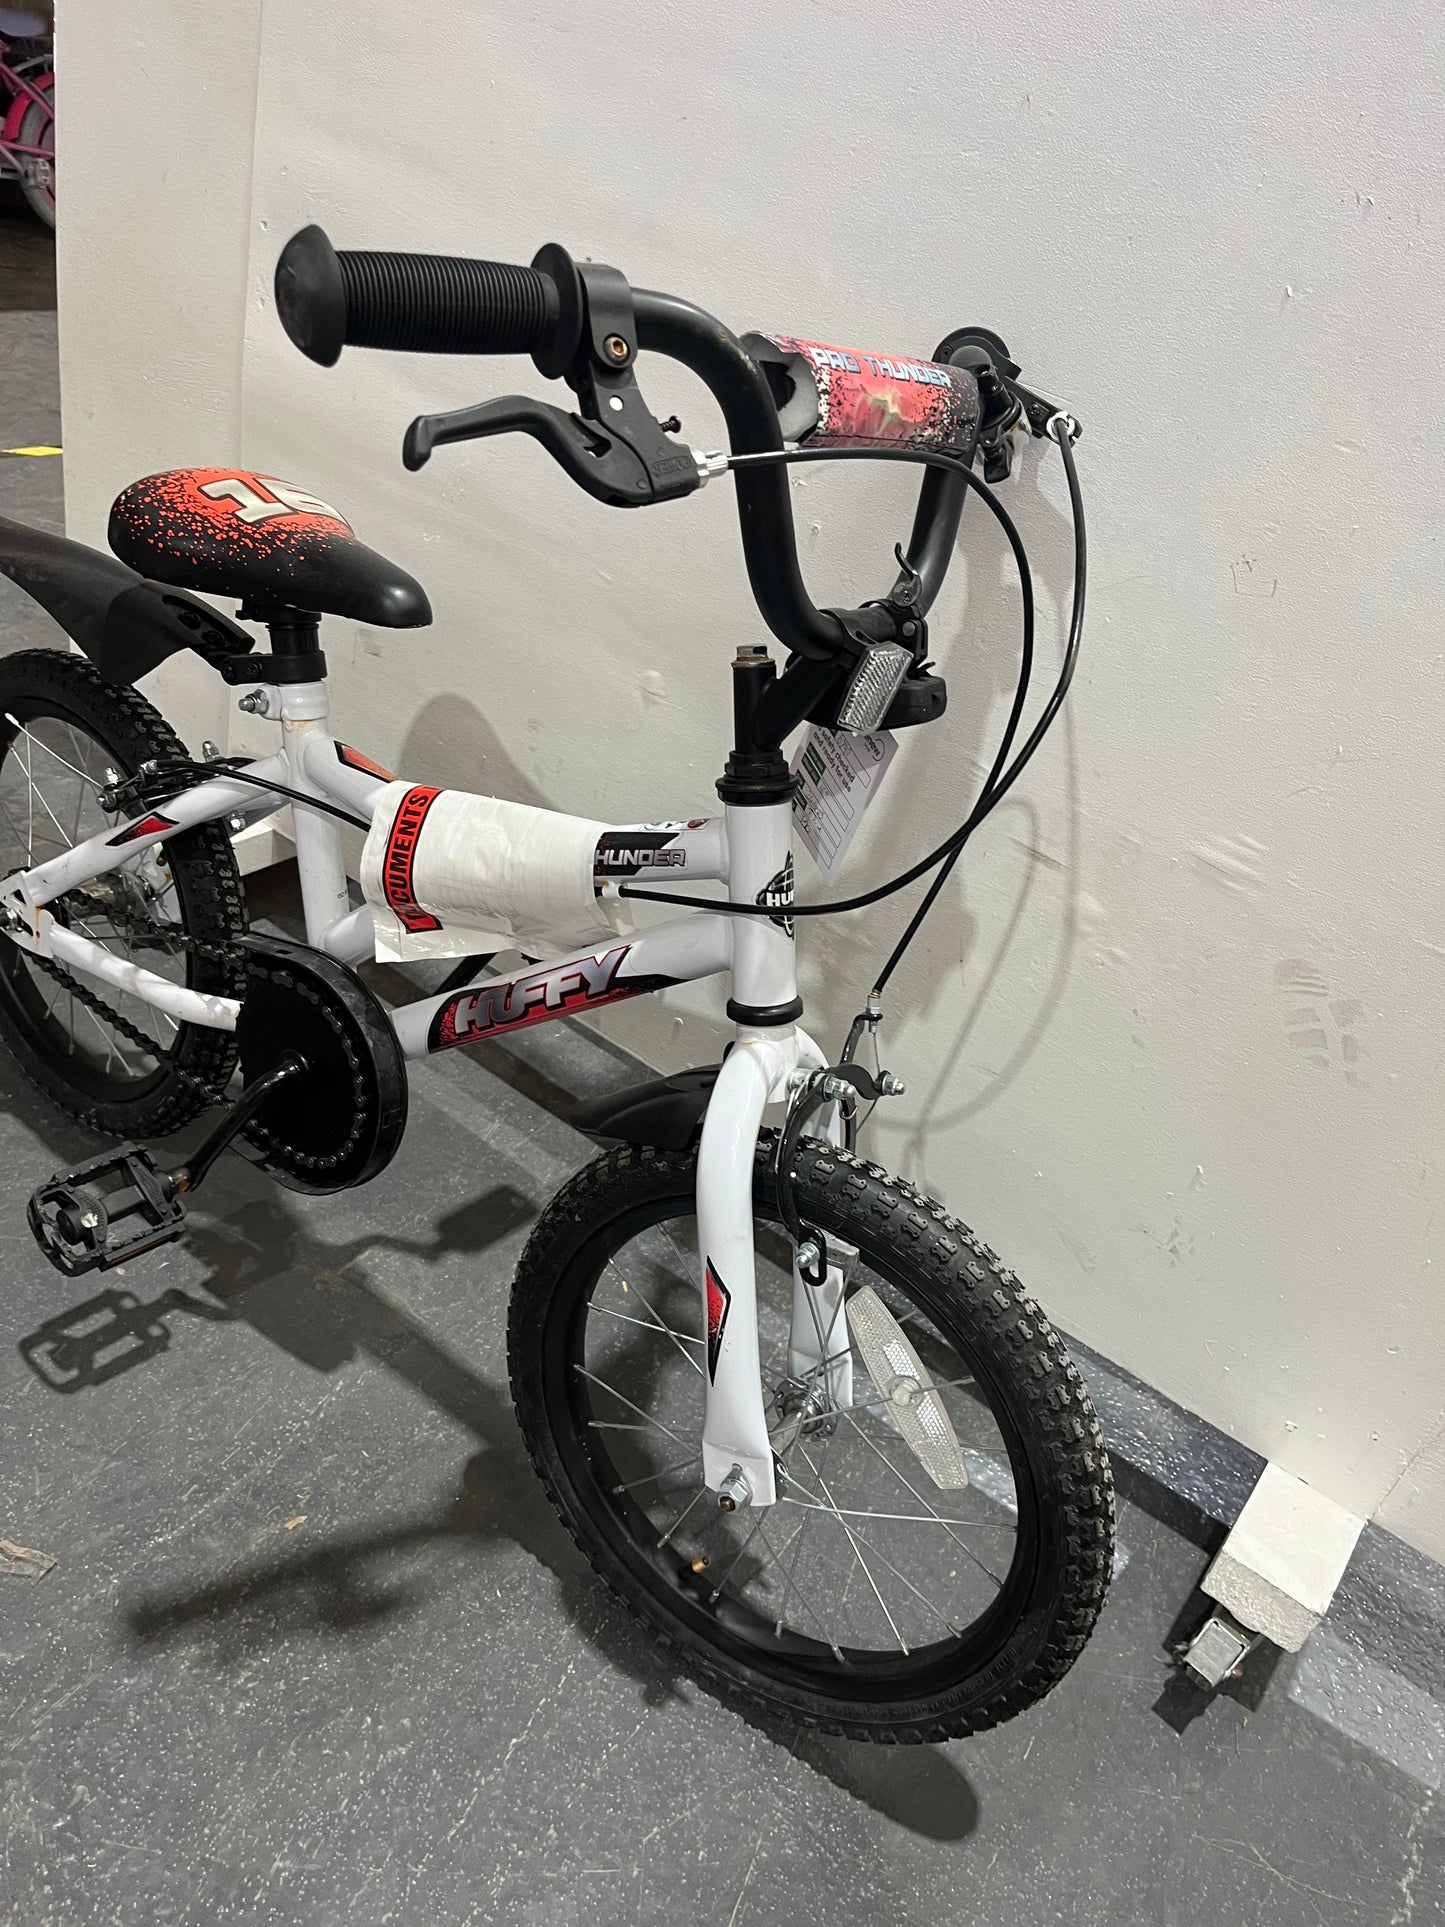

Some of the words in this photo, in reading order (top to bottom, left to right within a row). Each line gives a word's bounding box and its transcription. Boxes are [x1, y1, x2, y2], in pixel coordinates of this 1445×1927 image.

[809, 347, 861, 373] PRO
[862, 355, 951, 387] THUNDER
[822, 746, 835, 768] ready
[842, 778, 851, 792] use
[835, 752, 855, 782] checked
[595, 848, 687, 867] HUNDER
[455, 945, 632, 1033] HUFFY
